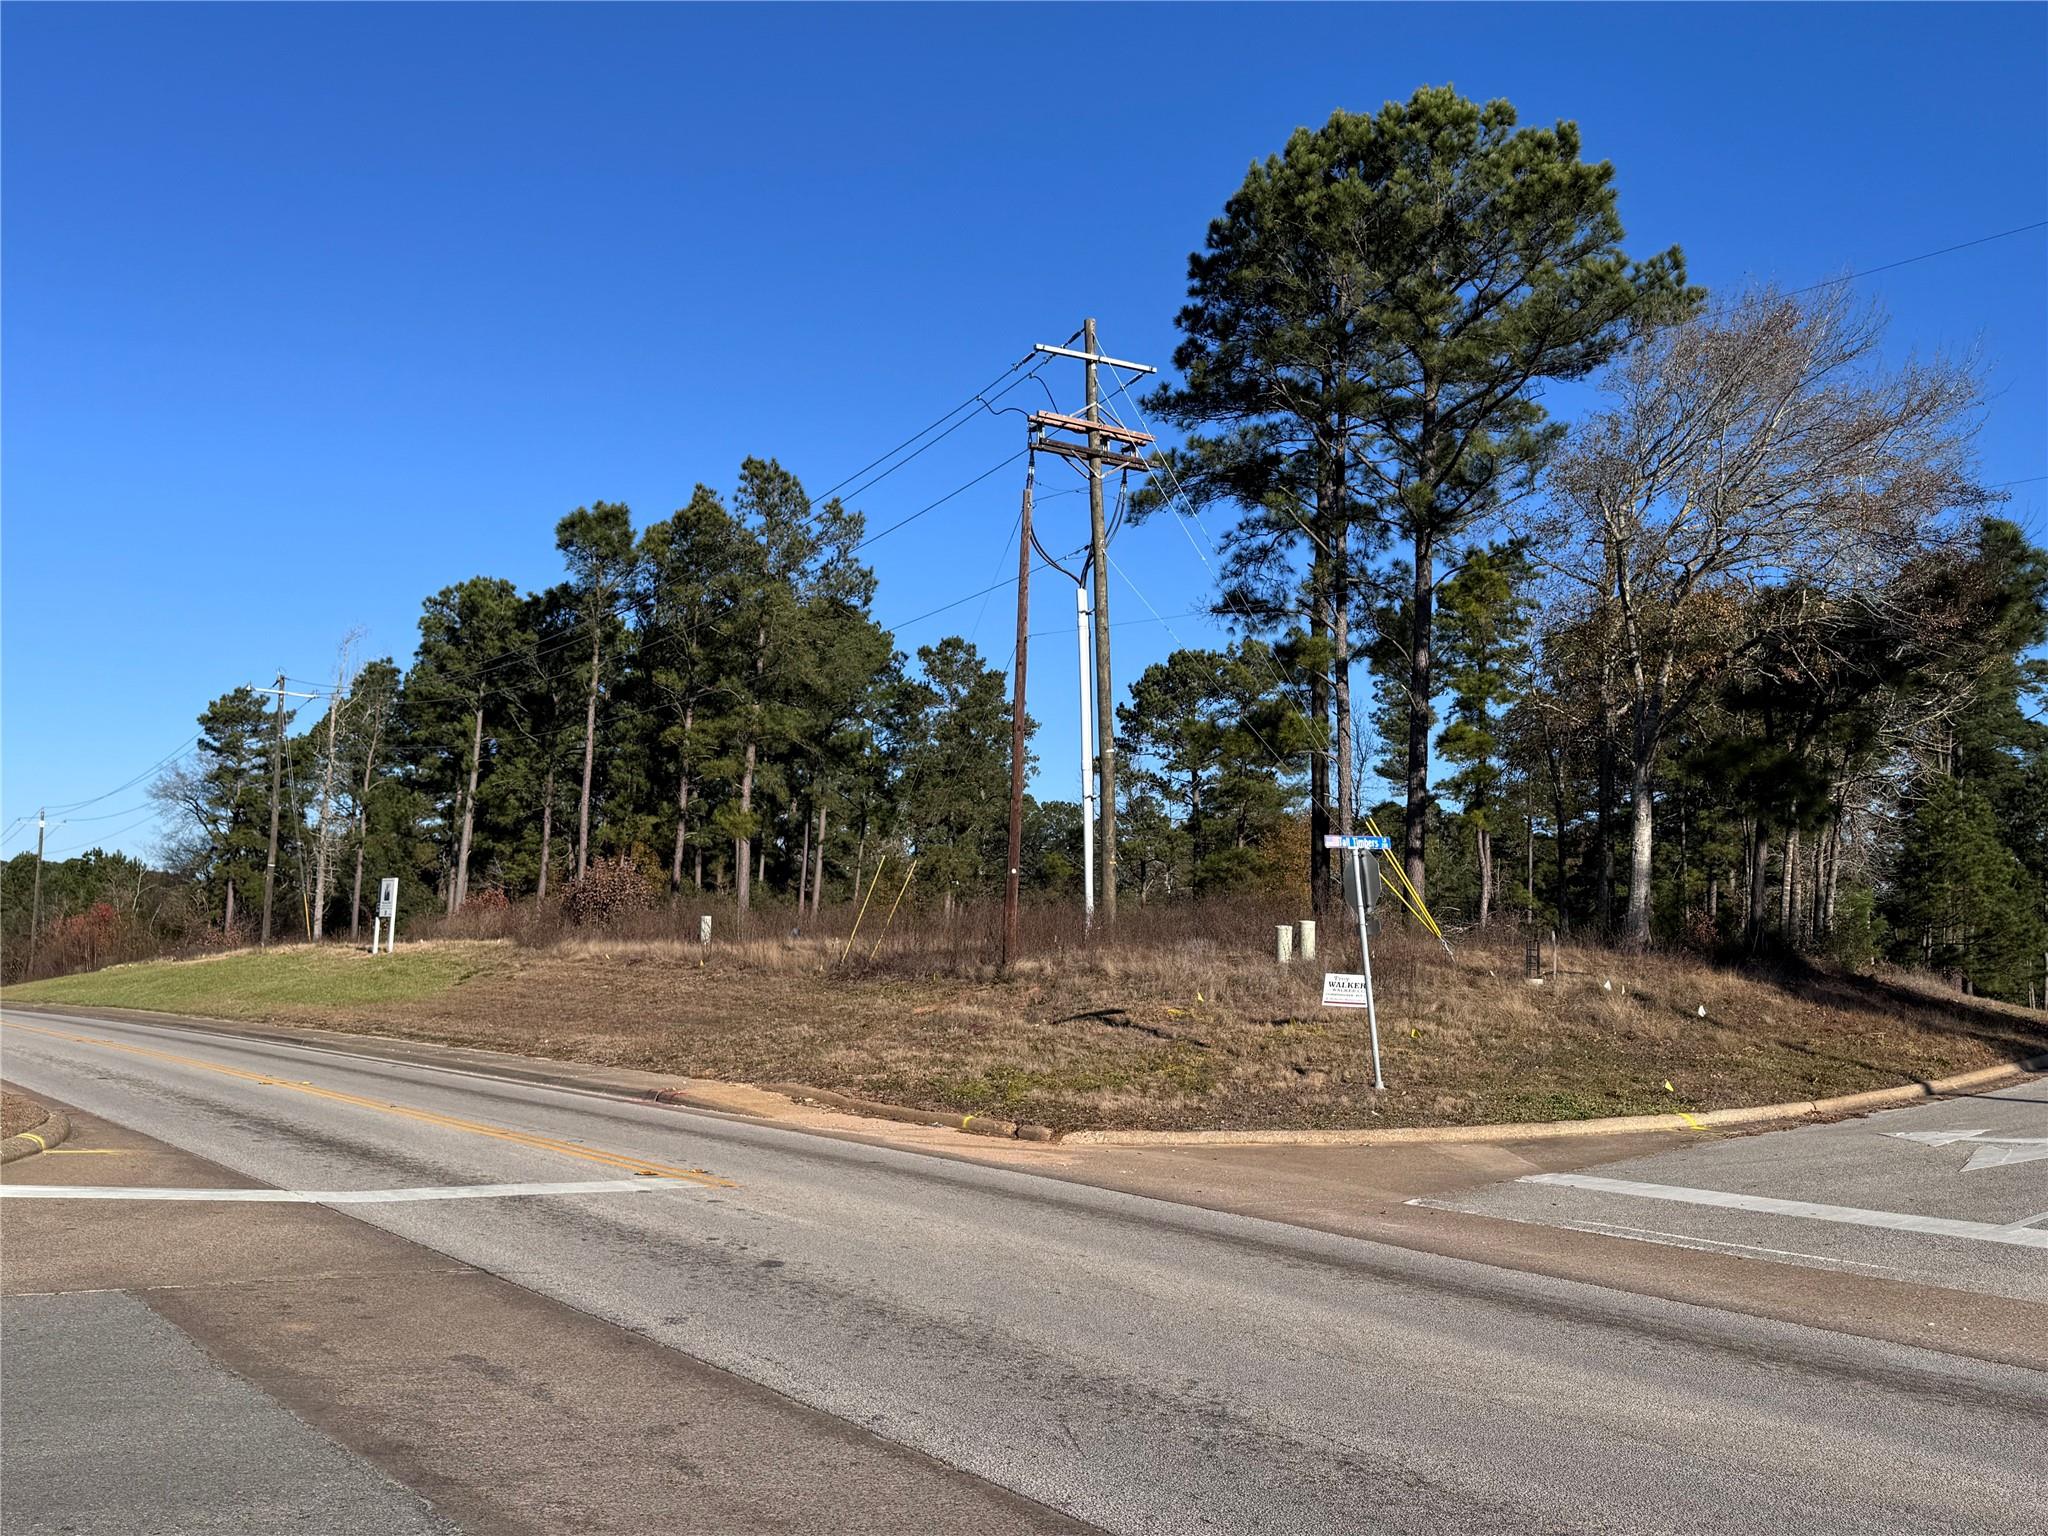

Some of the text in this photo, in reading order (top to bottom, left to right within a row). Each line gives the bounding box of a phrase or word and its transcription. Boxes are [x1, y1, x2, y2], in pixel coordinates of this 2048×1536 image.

[1339, 837, 1350, 847] Tall
[1353, 837, 1379, 848] Timbers
[1328, 981, 1366, 989] WALKER
